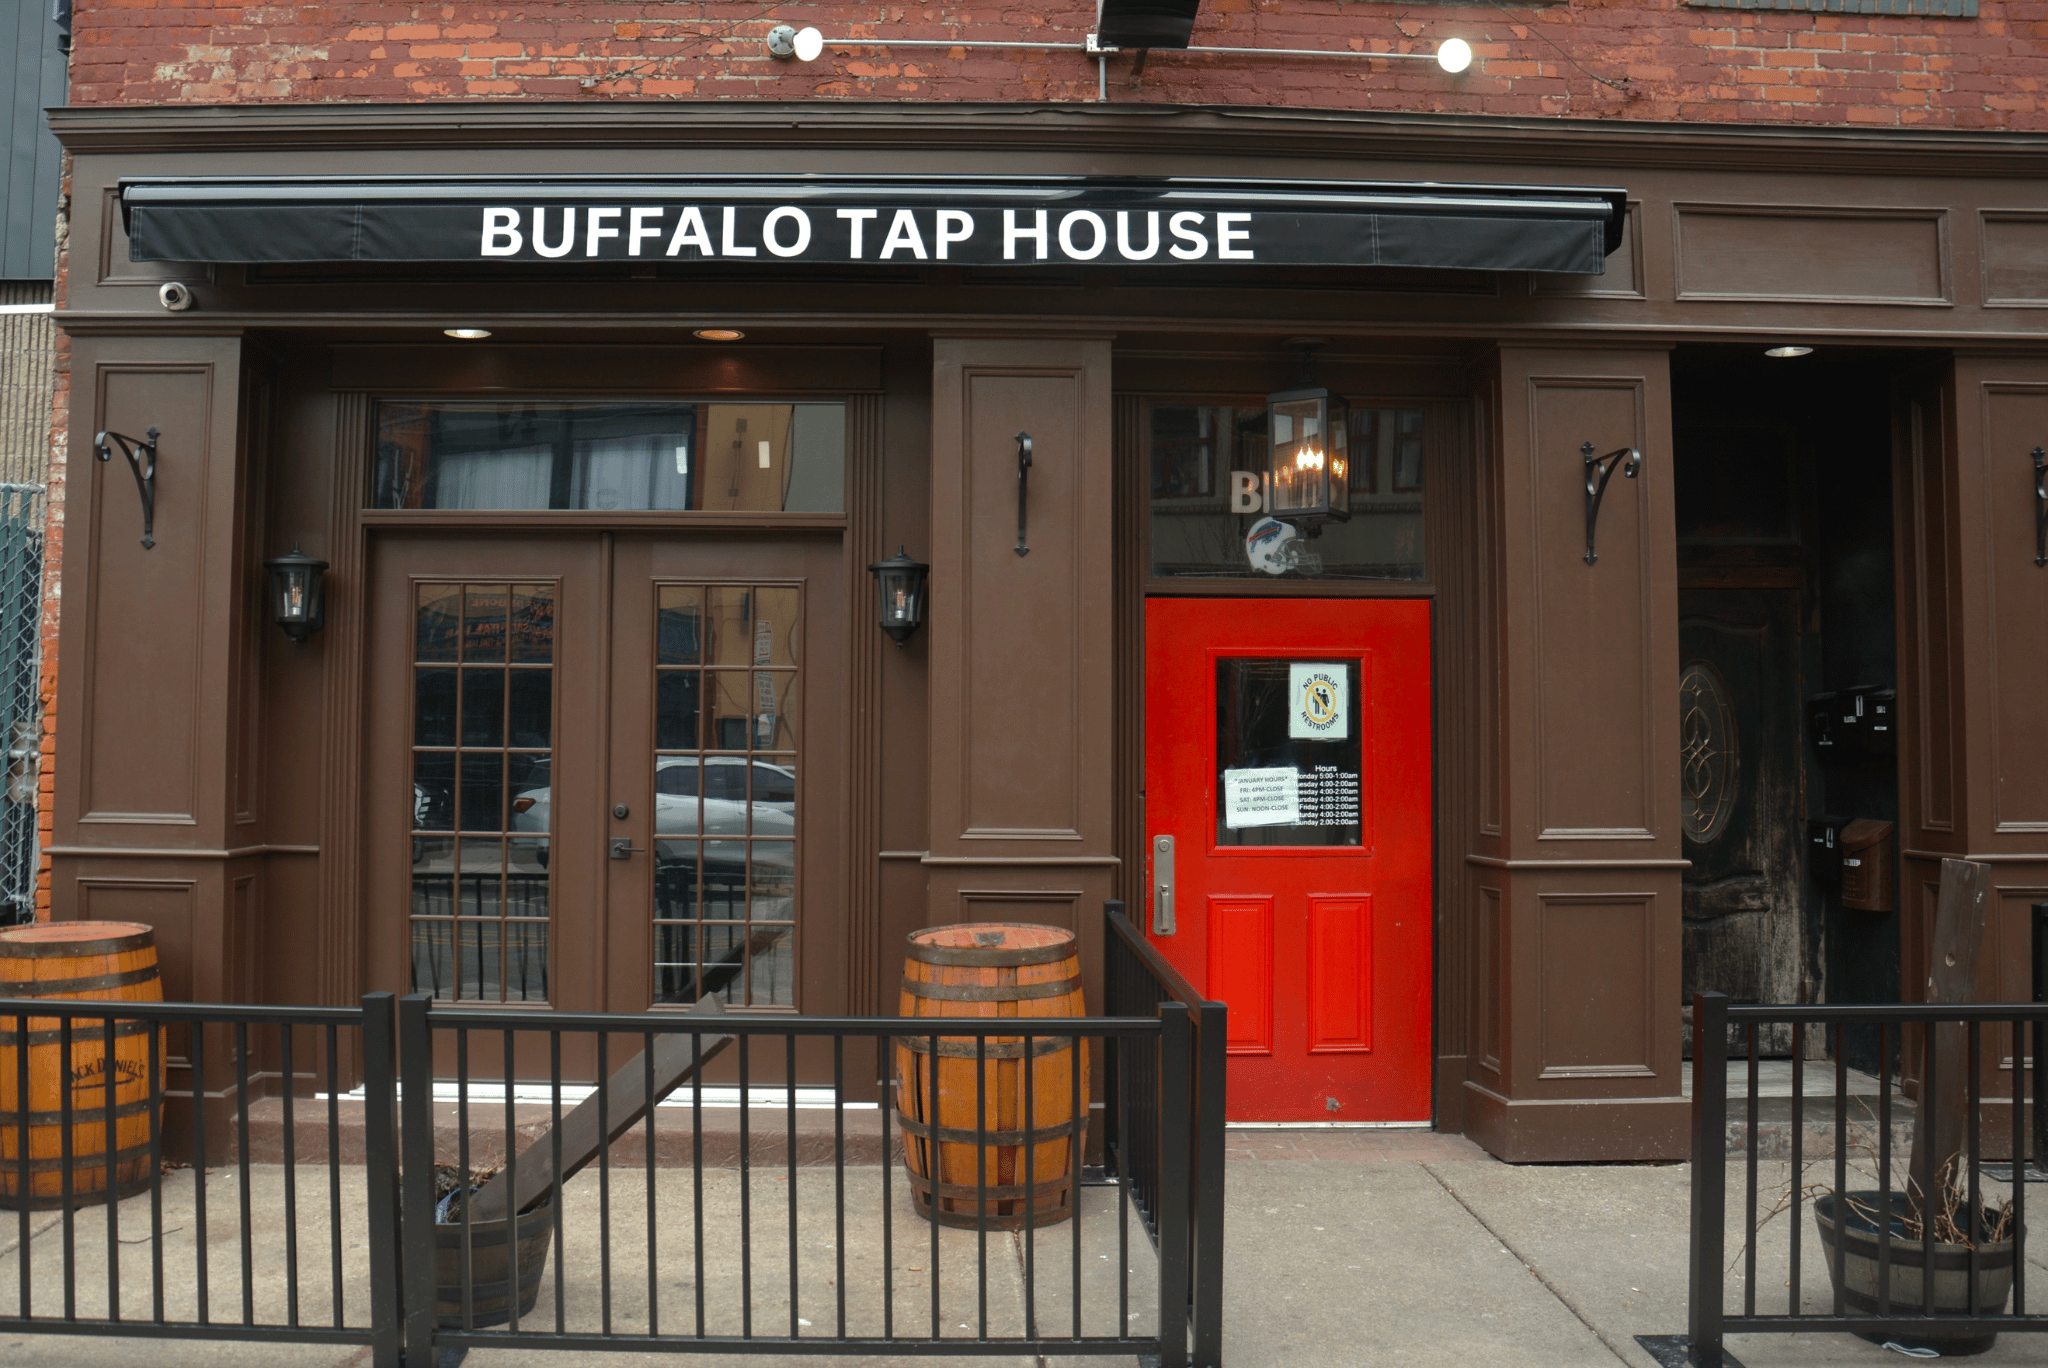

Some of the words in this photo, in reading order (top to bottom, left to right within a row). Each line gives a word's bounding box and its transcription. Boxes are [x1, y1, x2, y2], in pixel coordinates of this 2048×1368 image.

[481, 206, 812, 258] BUFFALO
[836, 208, 975, 260] TAP
[1003, 209, 1255, 261] HOUSE
[1302, 677, 1313, 690] NO
[1313, 673, 1338, 690] PUBLIC
[1301, 710, 1339, 731] RESTROOMS
[1251, 804, 1289, 812] NOON-CLOSE
[1299, 803, 1318, 811] Friday
[96, 1057, 145, 1079] DNIEL'S
